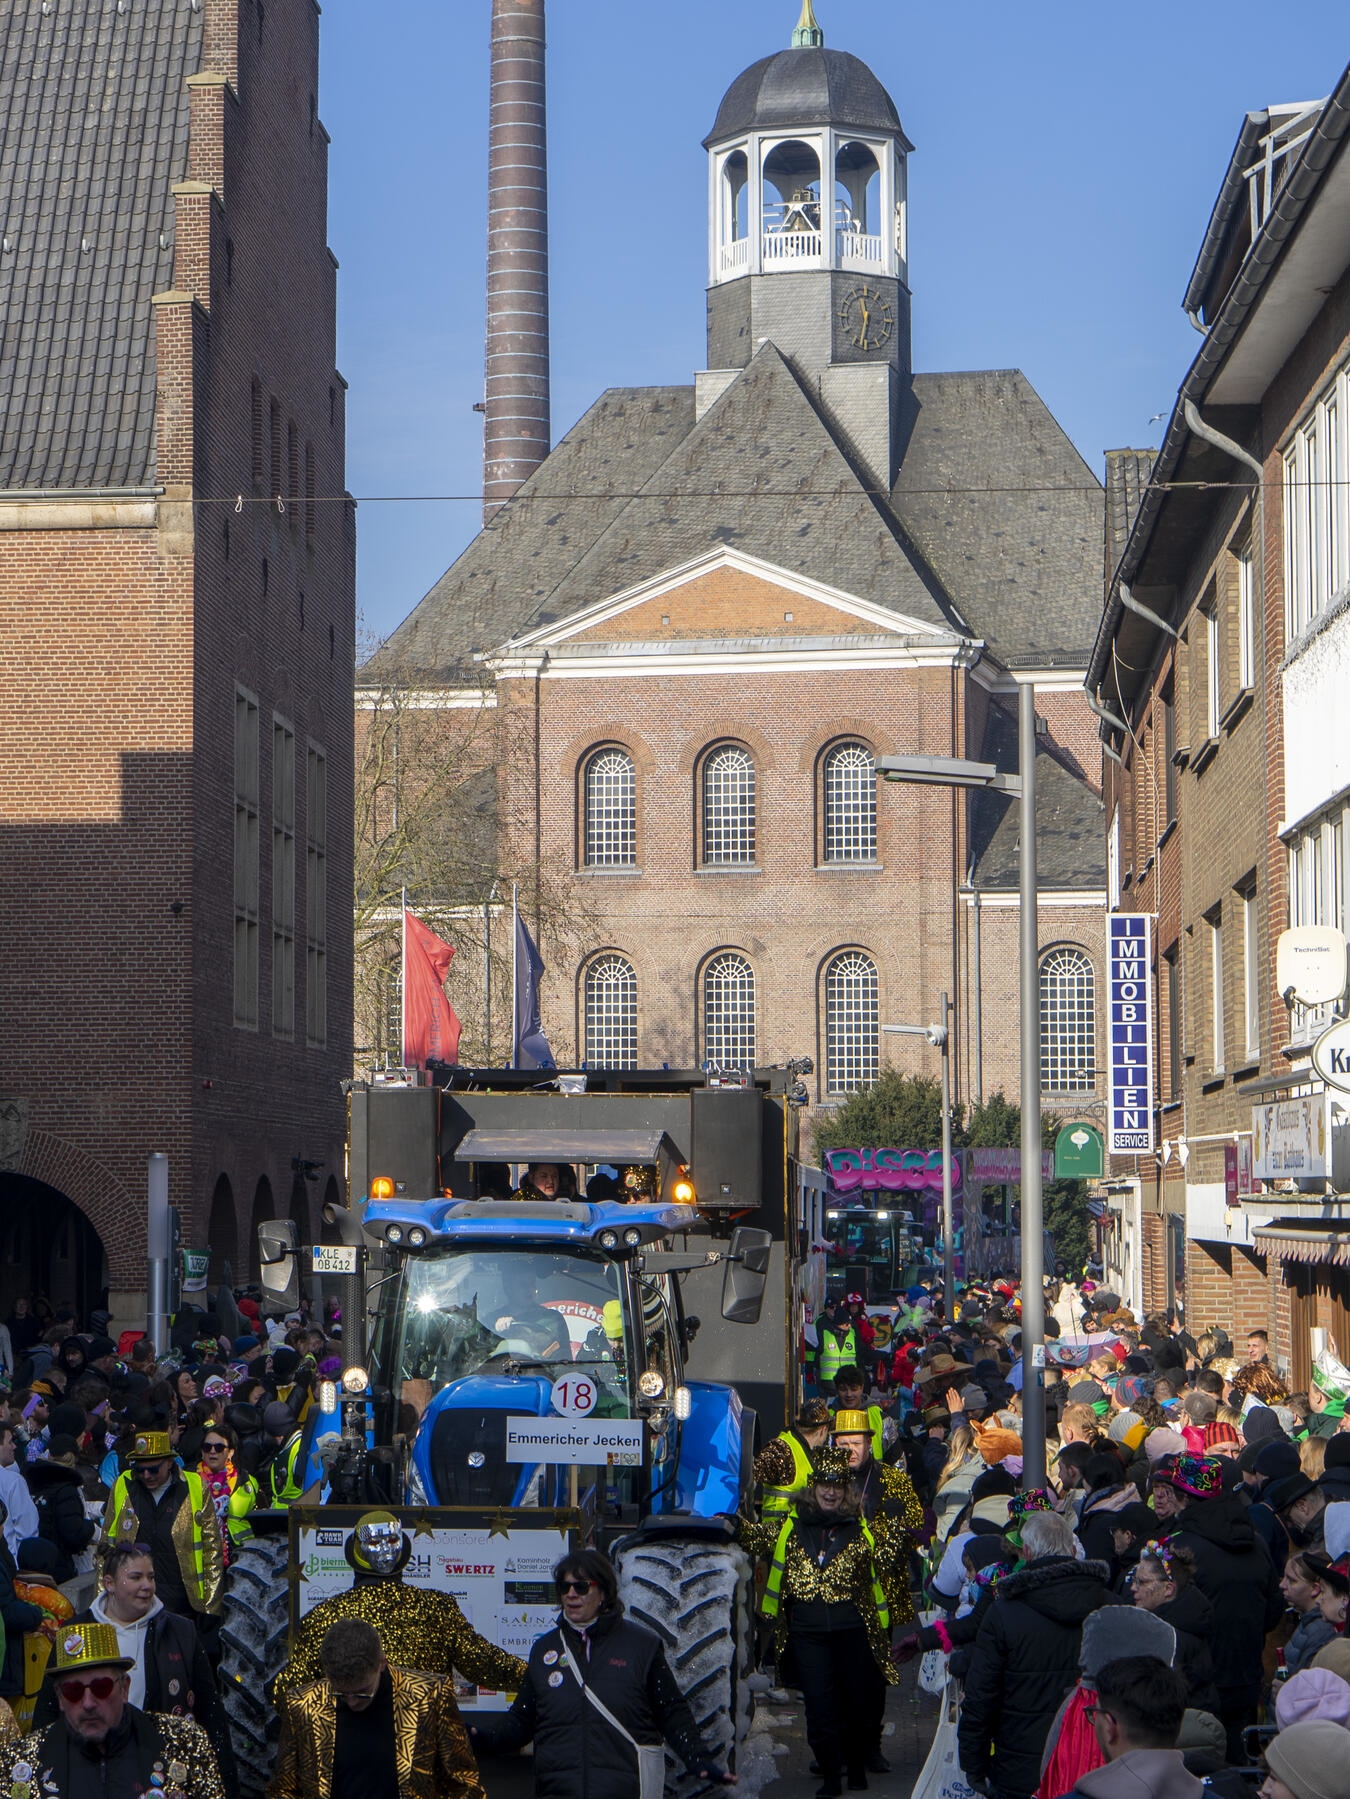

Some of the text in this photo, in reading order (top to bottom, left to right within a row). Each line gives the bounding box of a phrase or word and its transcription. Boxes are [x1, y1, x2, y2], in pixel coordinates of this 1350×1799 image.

[1118, 917, 1141, 1129] IMMOBILIEN
[1114, 1134, 1148, 1148] SERVICE
[319, 1248, 339, 1259] KLE
[317, 1259, 350, 1271] OB 412
[547, 1302, 605, 1323] eriche
[557, 1381, 592, 1410] 18
[508, 1432, 641, 1447] Emmericher Jecken
[321, 1557, 347, 1566] bierm
[445, 1564, 495, 1574] SWERTZ
[501, 1614, 557, 1624] SAUNA
